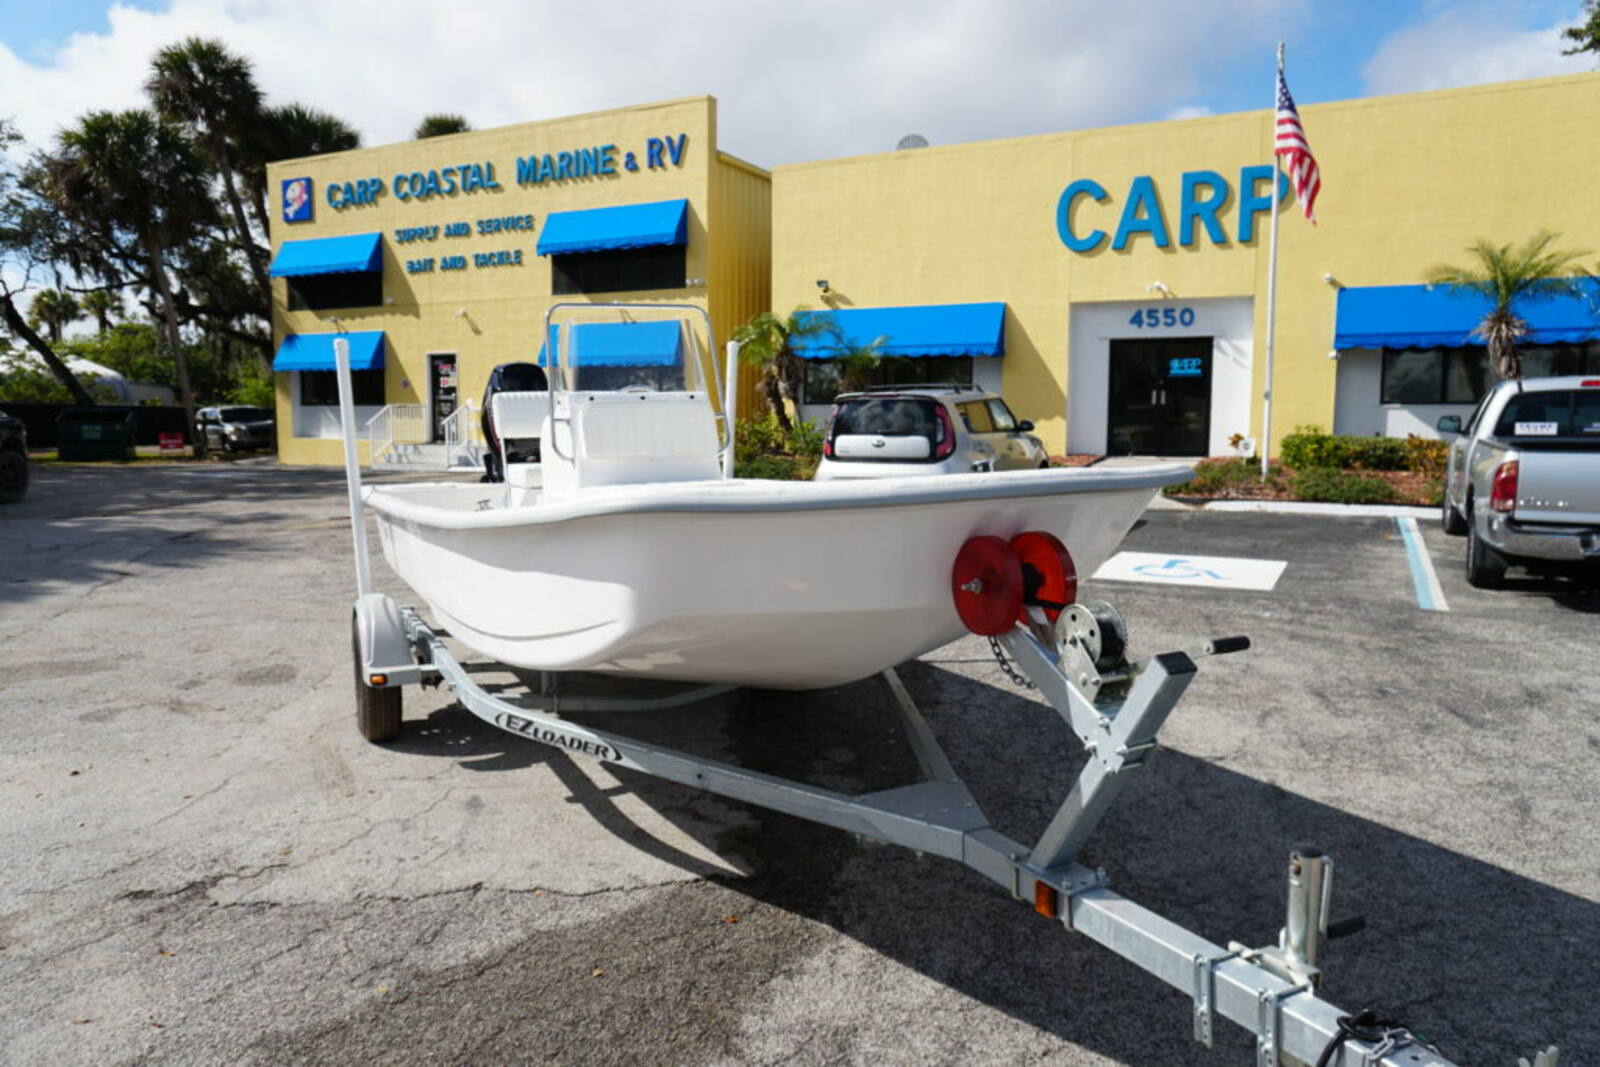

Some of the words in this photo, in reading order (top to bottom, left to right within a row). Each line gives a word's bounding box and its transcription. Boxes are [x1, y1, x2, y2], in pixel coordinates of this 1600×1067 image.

[326, 176, 384, 209] CARP
[392, 161, 500, 200] COASTAL
[516, 143, 616, 185] MARINE
[624, 151, 639, 171] &
[646, 133, 687, 169] RV
[1056, 165, 1290, 253] CARP
[443, 221, 471, 238] AND
[476, 214, 534, 235] SERVICE
[406, 257, 434, 274] BAIT
[440, 255, 467, 270] AND
[1129, 307, 1195, 329] 4550
